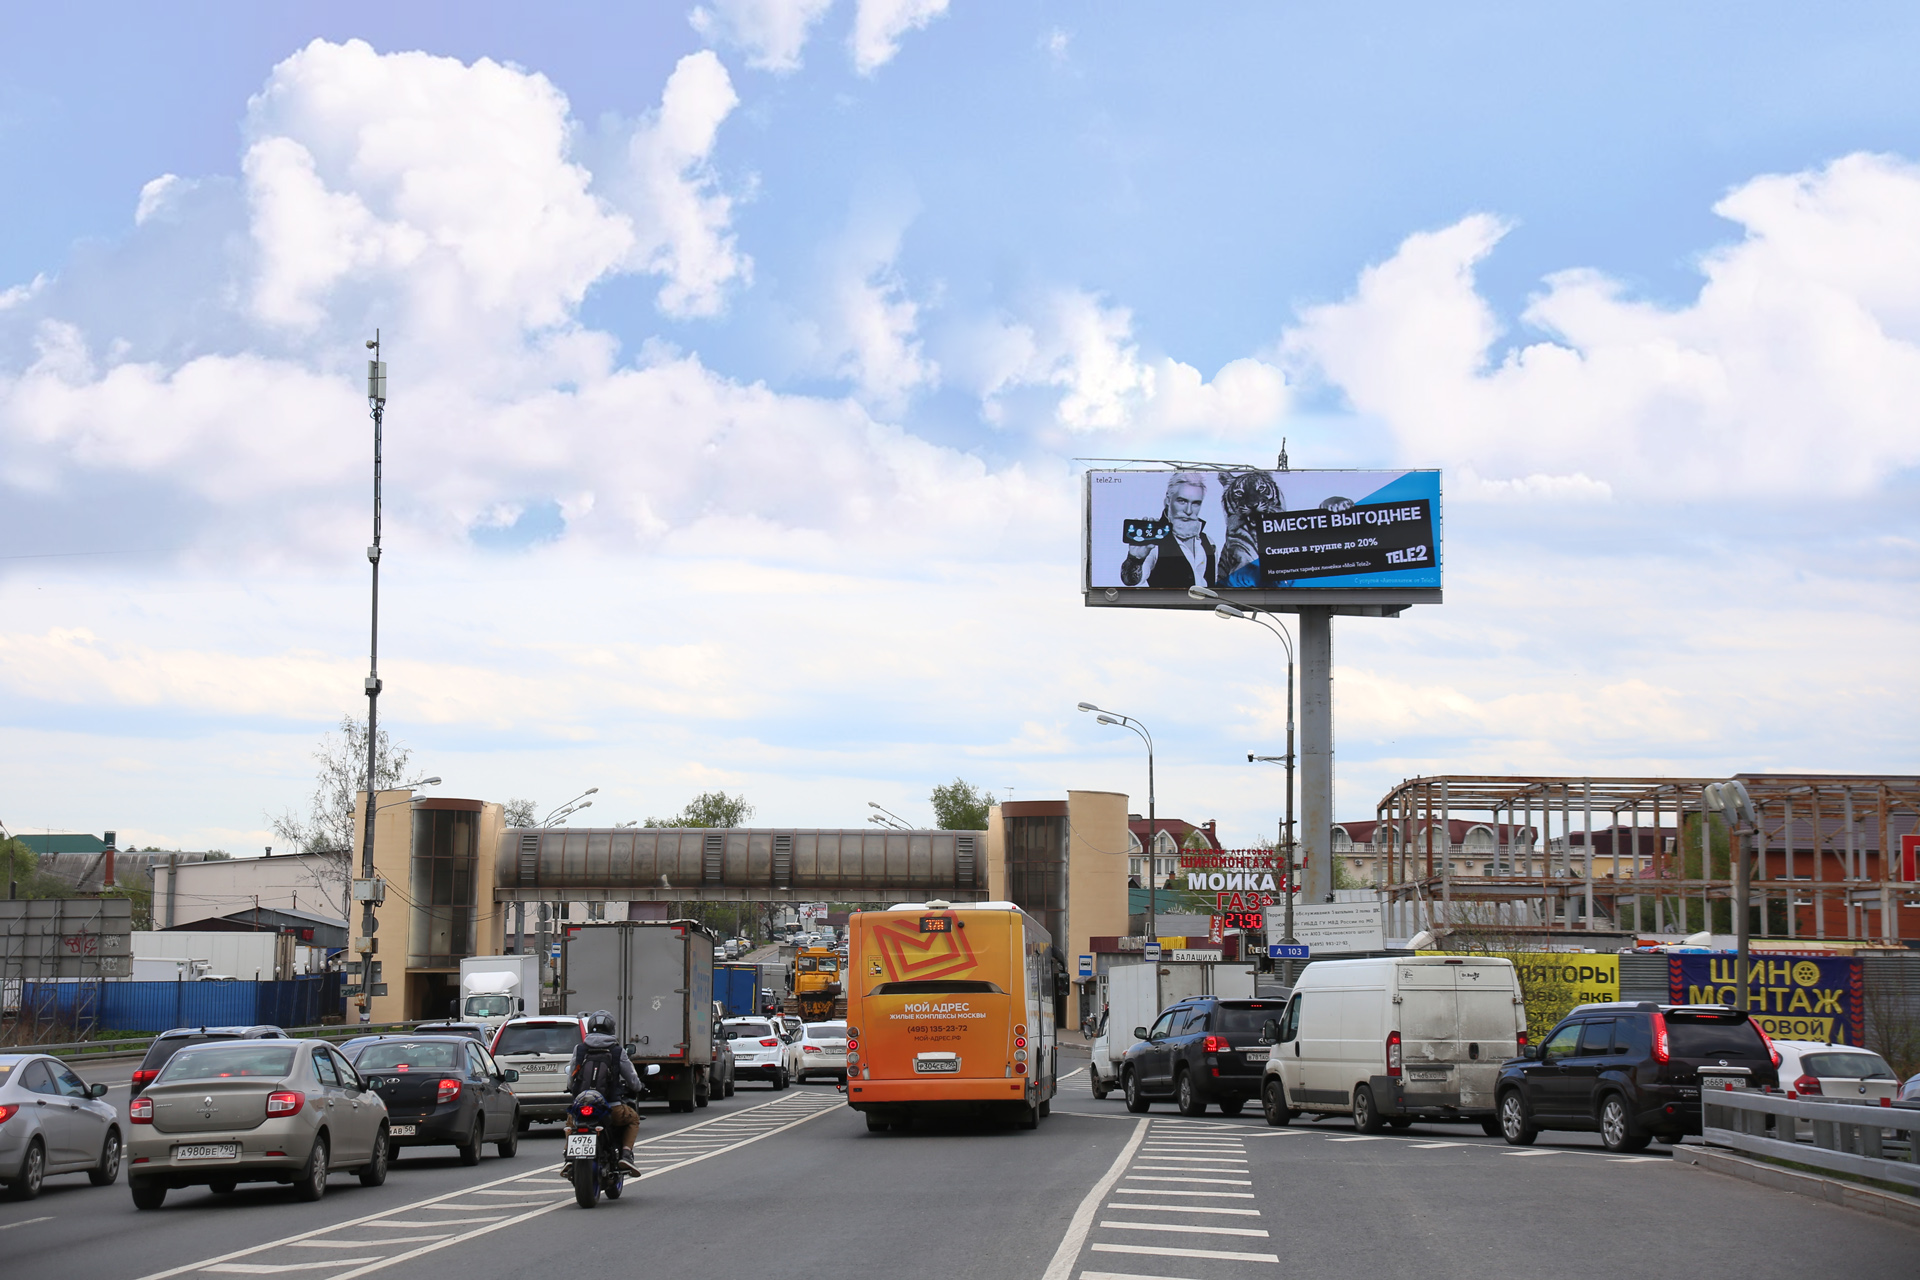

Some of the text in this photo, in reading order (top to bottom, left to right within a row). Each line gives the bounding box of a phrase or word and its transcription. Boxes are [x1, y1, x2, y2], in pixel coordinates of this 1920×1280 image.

[1262, 506, 1422, 533] ВМЕСТЕ ВЫГОДНЕЕ
[1265, 546, 1300, 555] Скидка
[1309, 542, 1342, 553] группе
[1344, 541, 1356, 549] до
[1357, 537, 1379, 547] 20%
[1385, 544, 1428, 565] TELE2
[1180, 856, 1274, 869] ШИНОМОНТАЖ
[1216, 892, 1260, 911] ГАЗ
[1225, 912, 1263, 929] 27.90
[1175, 953, 1218, 961] БАЛАШИХА
[904, 1001, 970, 1013] МОЙ АДРЕС
[907, 1025, 928, 1033] (495)
[572, 1136, 593, 1144] 4976
[180, 1145, 234, 1157] А980ВЕ 790
[569, 1147, 594, 1155] АС 50
